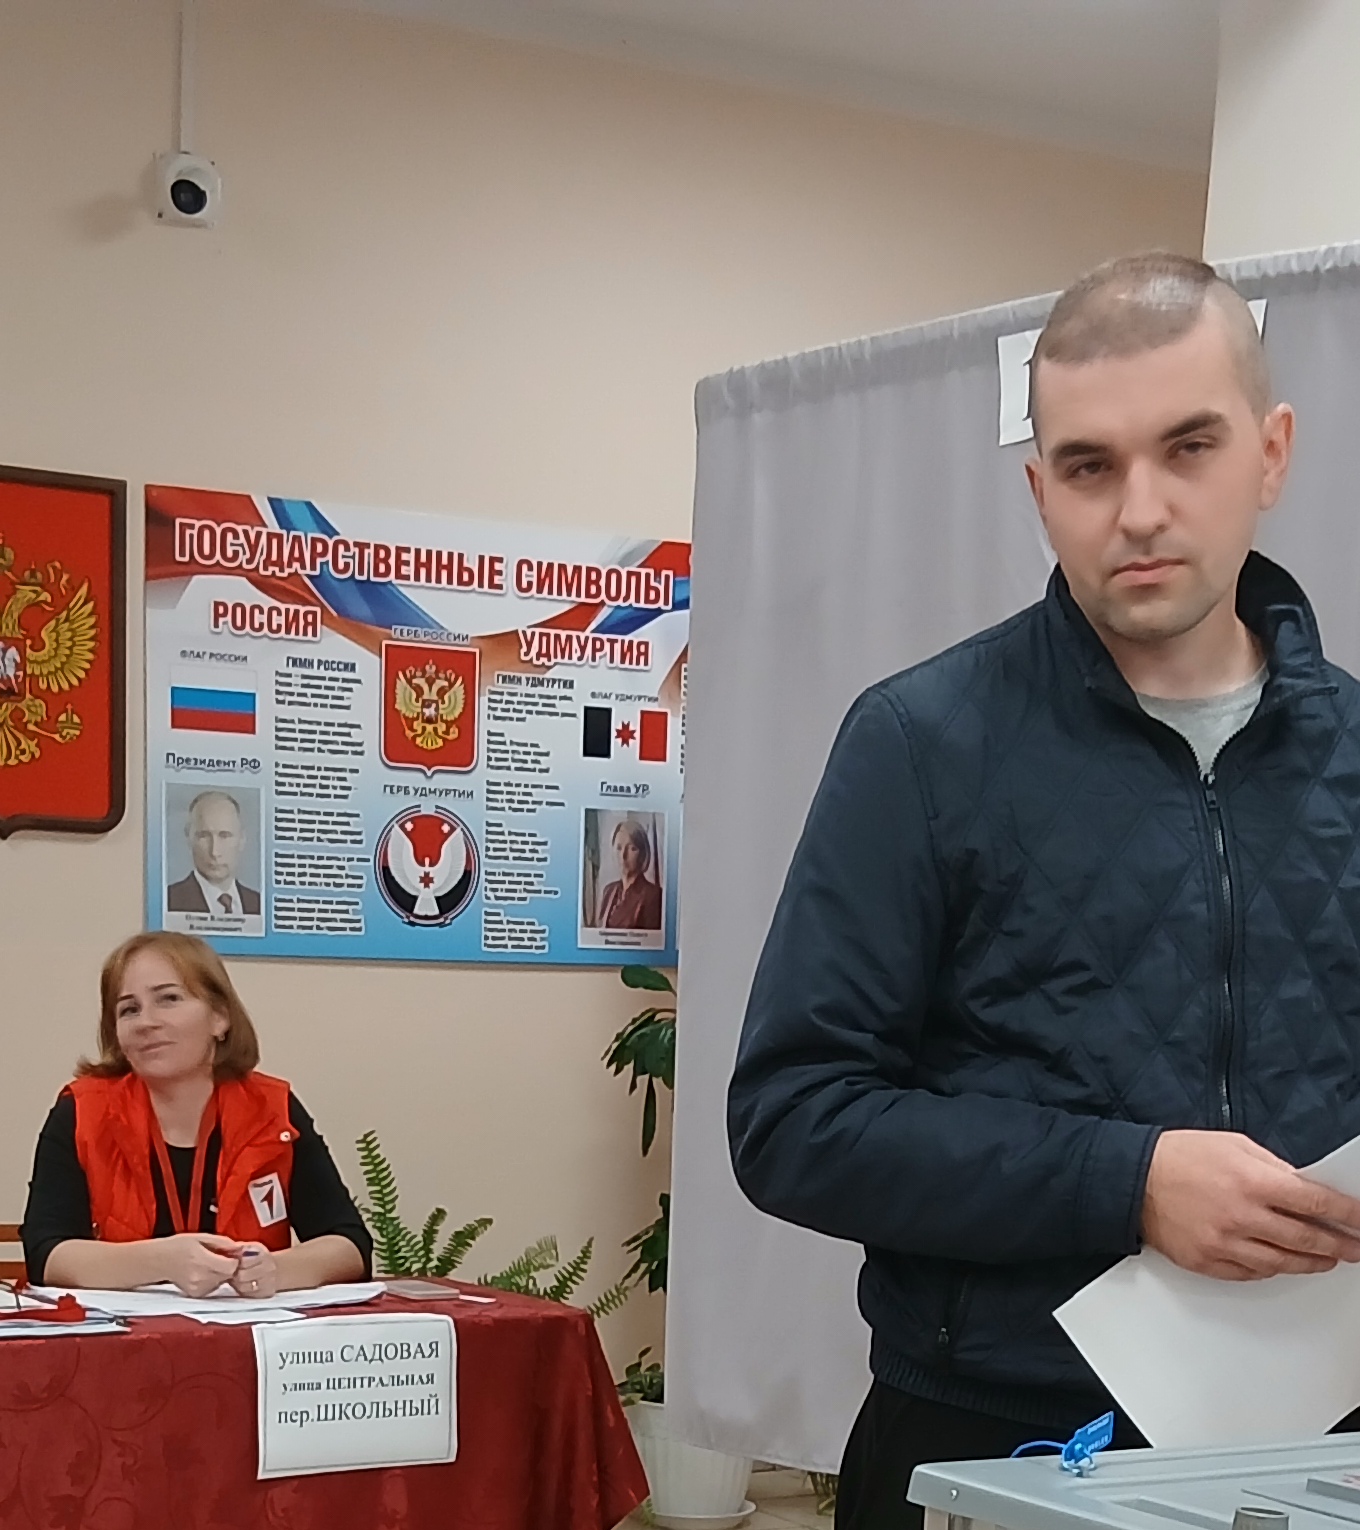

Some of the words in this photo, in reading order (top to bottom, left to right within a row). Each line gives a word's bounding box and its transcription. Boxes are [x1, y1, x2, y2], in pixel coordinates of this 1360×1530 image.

[178, 521, 504, 591] ГОСУДАРСТВЕННЫЕ
[515, 558, 671, 607] СИМВОЛЫ
[213, 601, 318, 638] РОССИЯ
[393, 627, 420, 639] ГЕРБ
[423, 630, 469, 643] РОССИИ
[180, 650, 207, 660] ФЛАГ
[209, 652, 248, 663] РОССИИ
[521, 629, 651, 668] УДМУРТИЯ
[317, 659, 356, 674] РОССИИ
[166, 752, 237, 769] Президент
[240, 757, 261, 770] РФ
[383, 784, 410, 796] ГЕРБ
[412, 786, 474, 800] УДМУРТИИ
[600, 782, 631, 794] Глава
[633, 784, 650, 795] УР
[278, 1350, 334, 1370] улица
[340, 1341, 439, 1364] САДОВАЯ
[282, 1381, 322, 1395] улица
[326, 1373, 435, 1391] ЦЕНТРАЛЬНАЯ
[278, 1393, 440, 1428] пер.ШКОЛЬНЫЙ
